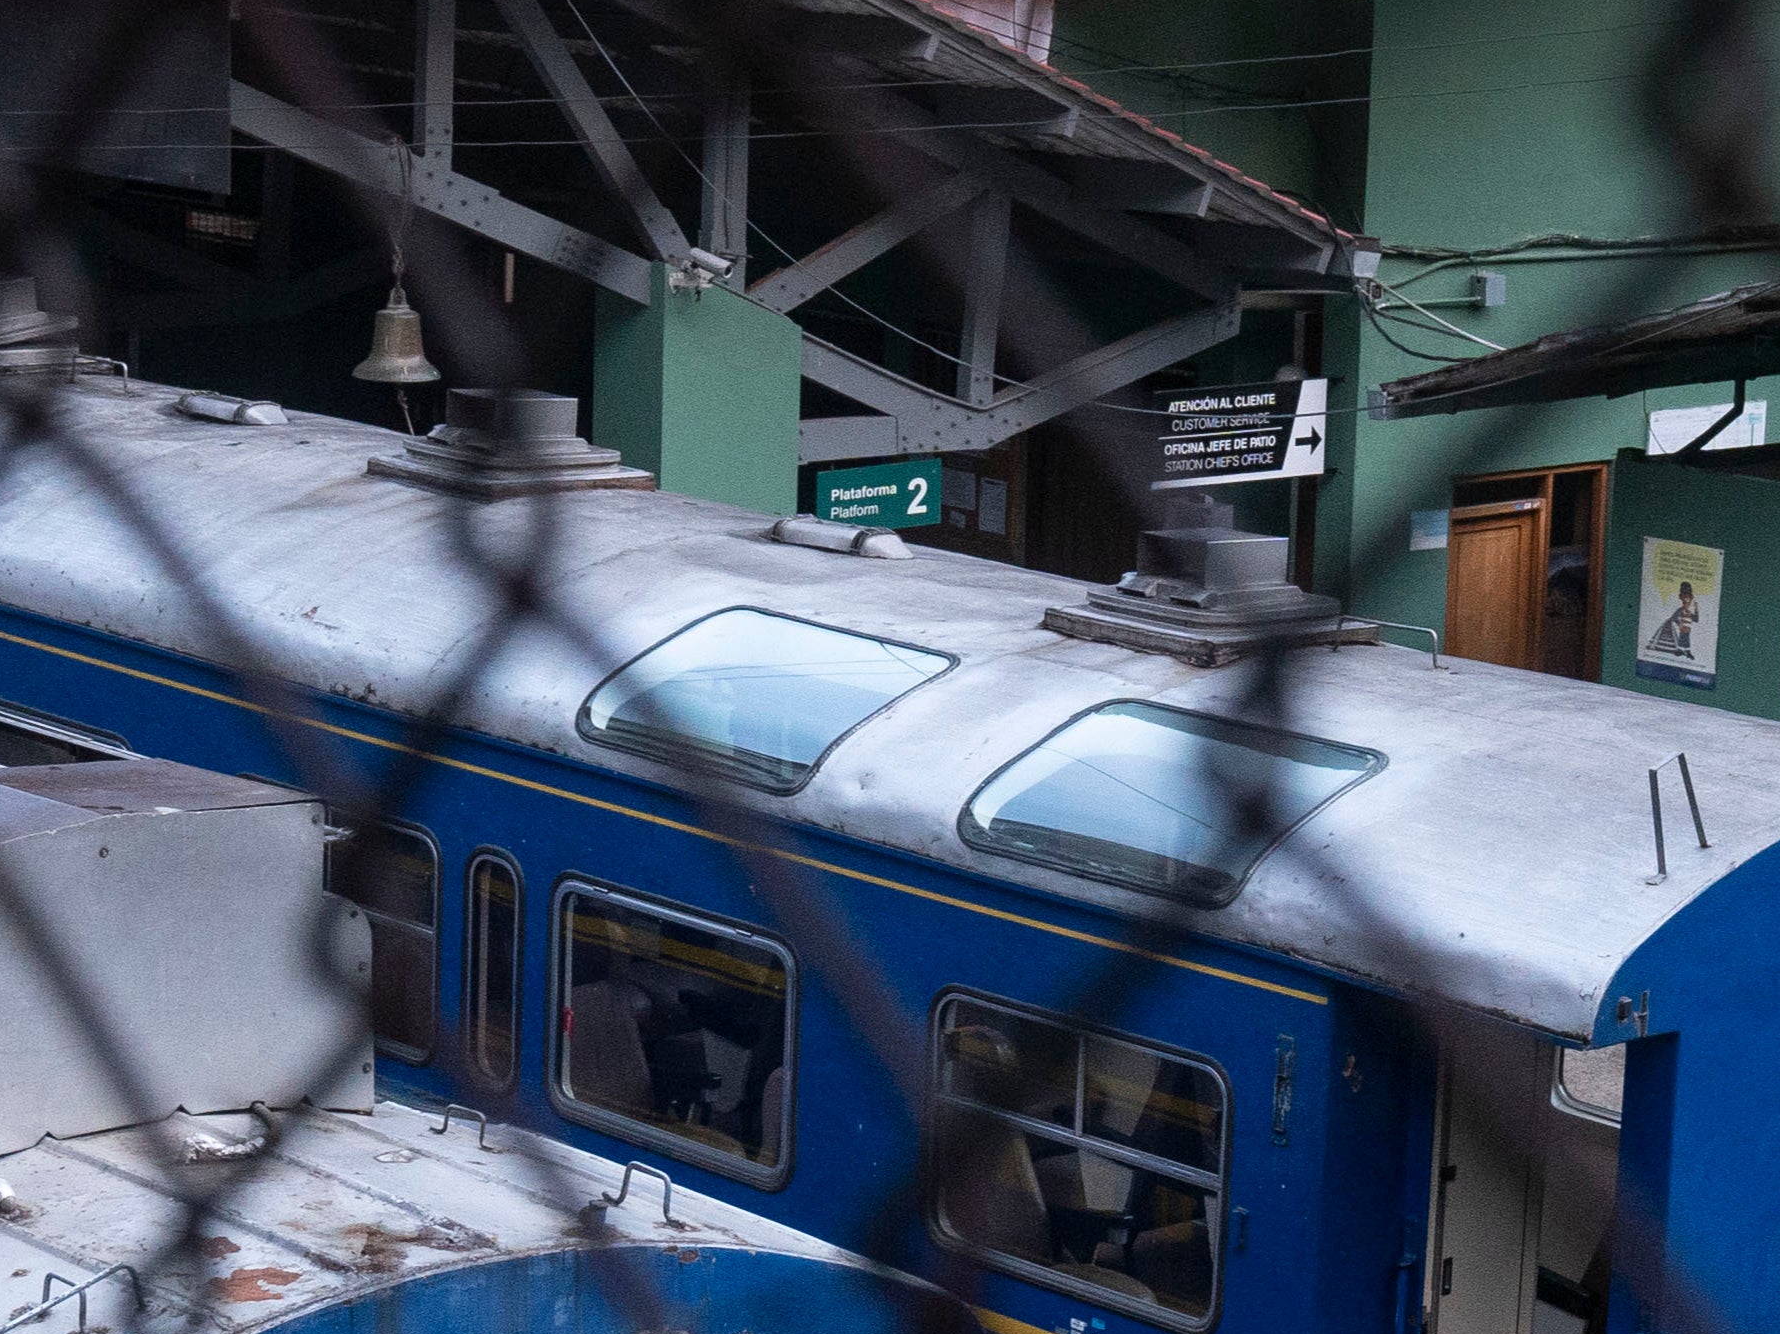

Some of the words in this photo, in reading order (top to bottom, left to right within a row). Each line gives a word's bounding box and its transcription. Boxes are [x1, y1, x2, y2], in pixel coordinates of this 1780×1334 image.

[1168, 396, 1218, 413] ATENCIÓN
[1220, 397, 1232, 409] AL
[1234, 393, 1276, 407] CLIENTE
[1171, 415, 1228, 432] CUSTOMER
[1230, 412, 1270, 427] SERVICE
[1164, 442, 1205, 456] OFICINA
[1207, 439, 1231, 452] JEFE
[1233, 438, 1246, 449] DE
[1249, 435, 1276, 448] PATIO
[1165, 459, 1204, 473] STATION
[1241, 452, 1274, 466] OFFICE
[831, 484, 897, 501] Plataforma
[907, 477, 928, 515] 2
[830, 504, 879, 520] Platform
